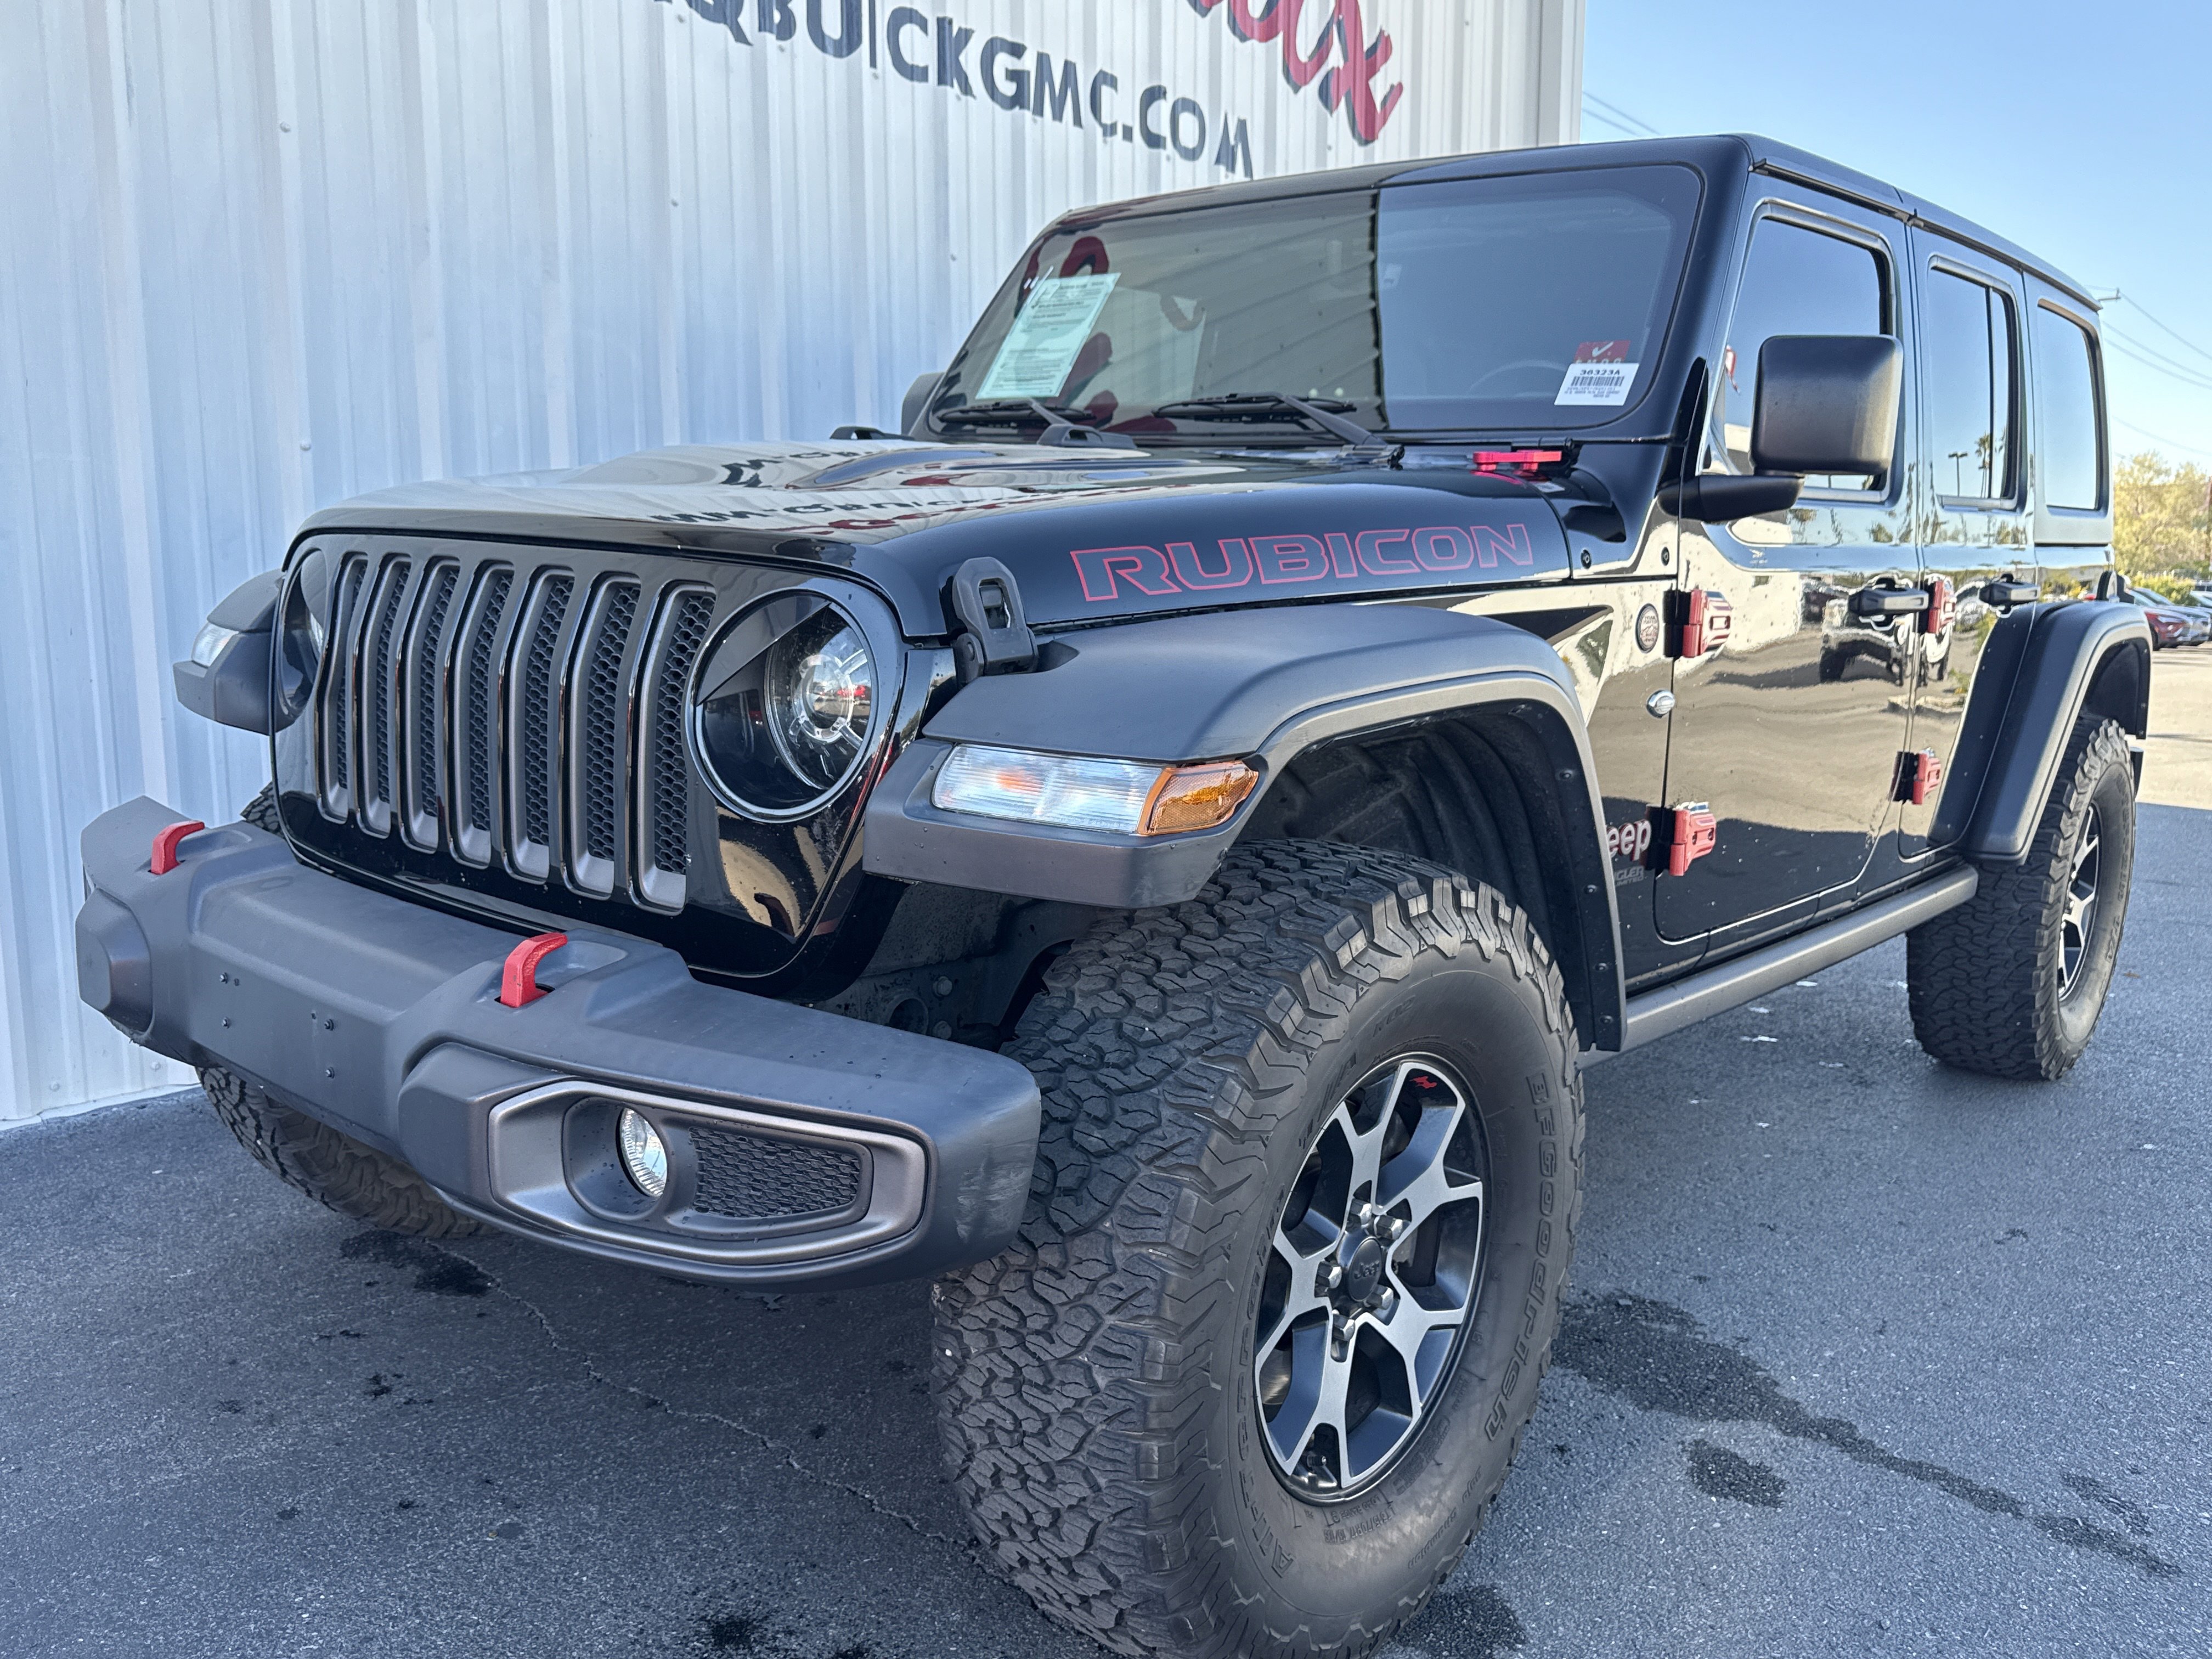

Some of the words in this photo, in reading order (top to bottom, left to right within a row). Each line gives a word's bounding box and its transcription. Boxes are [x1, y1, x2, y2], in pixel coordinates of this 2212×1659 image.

[1070, 523, 1534, 602] RUBICON
[1606, 819, 1651, 861] eep
[1616, 867, 1645, 880] GLER
[1483, 1071, 1558, 1444] BFGoodrich
